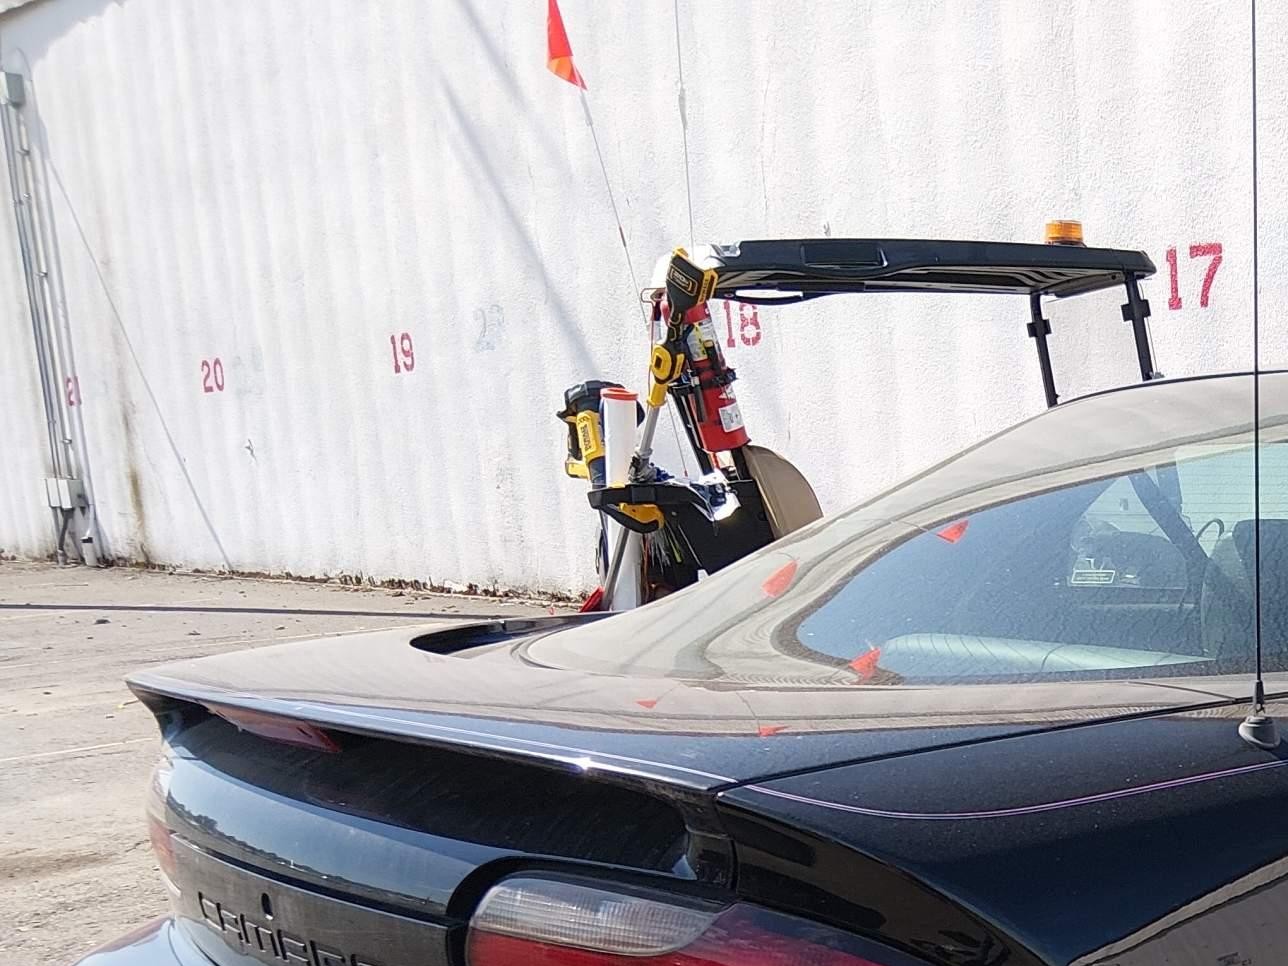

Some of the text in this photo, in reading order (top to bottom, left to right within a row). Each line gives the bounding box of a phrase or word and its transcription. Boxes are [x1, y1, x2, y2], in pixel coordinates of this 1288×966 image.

[1166, 243, 1223, 310] 17
[723, 300, 761, 348] 18
[390, 332, 415, 373] 19
[201, 358, 225, 393] 20
